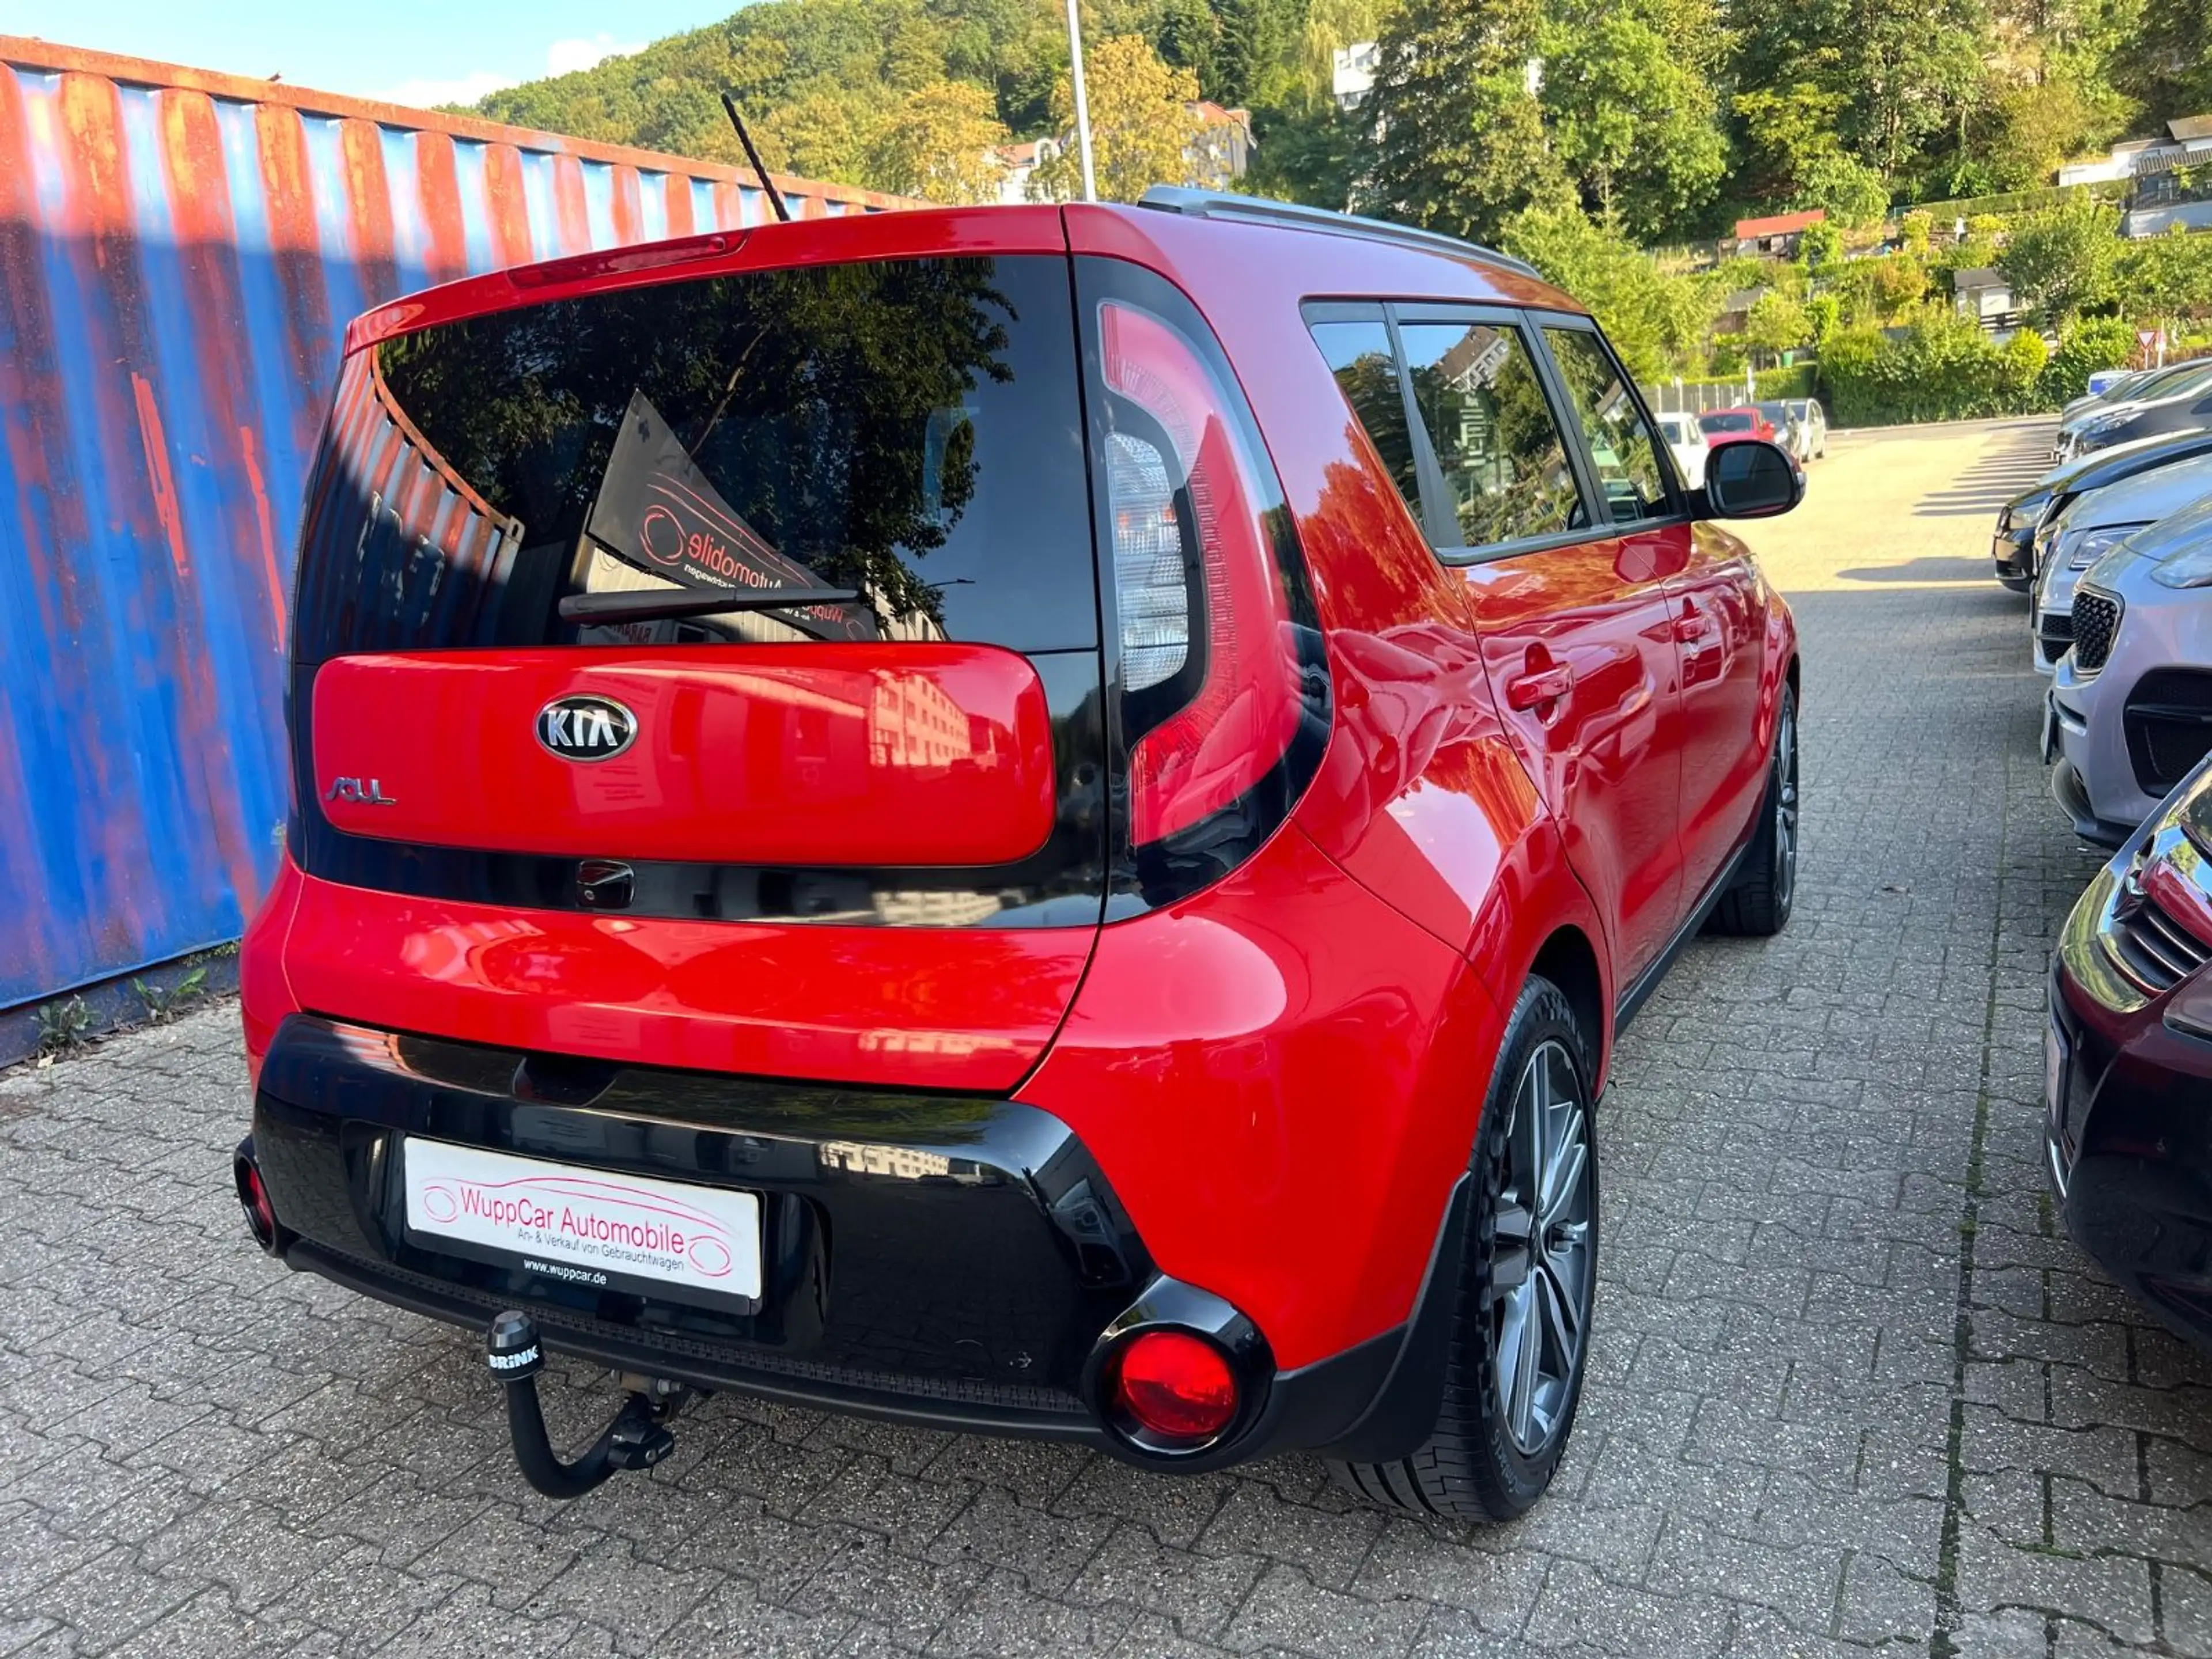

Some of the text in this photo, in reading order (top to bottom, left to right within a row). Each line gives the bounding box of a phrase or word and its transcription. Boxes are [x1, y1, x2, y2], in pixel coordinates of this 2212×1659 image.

[546, 709, 618, 747] KIA
[325, 776, 397, 806] SOUL
[461, 1186, 684, 1254] WuppCar Automobile
[518, 1228, 684, 1271] An- & Verkauf von Gebrauchtwagen
[524, 1259, 607, 1285] www.wuppcar.de
